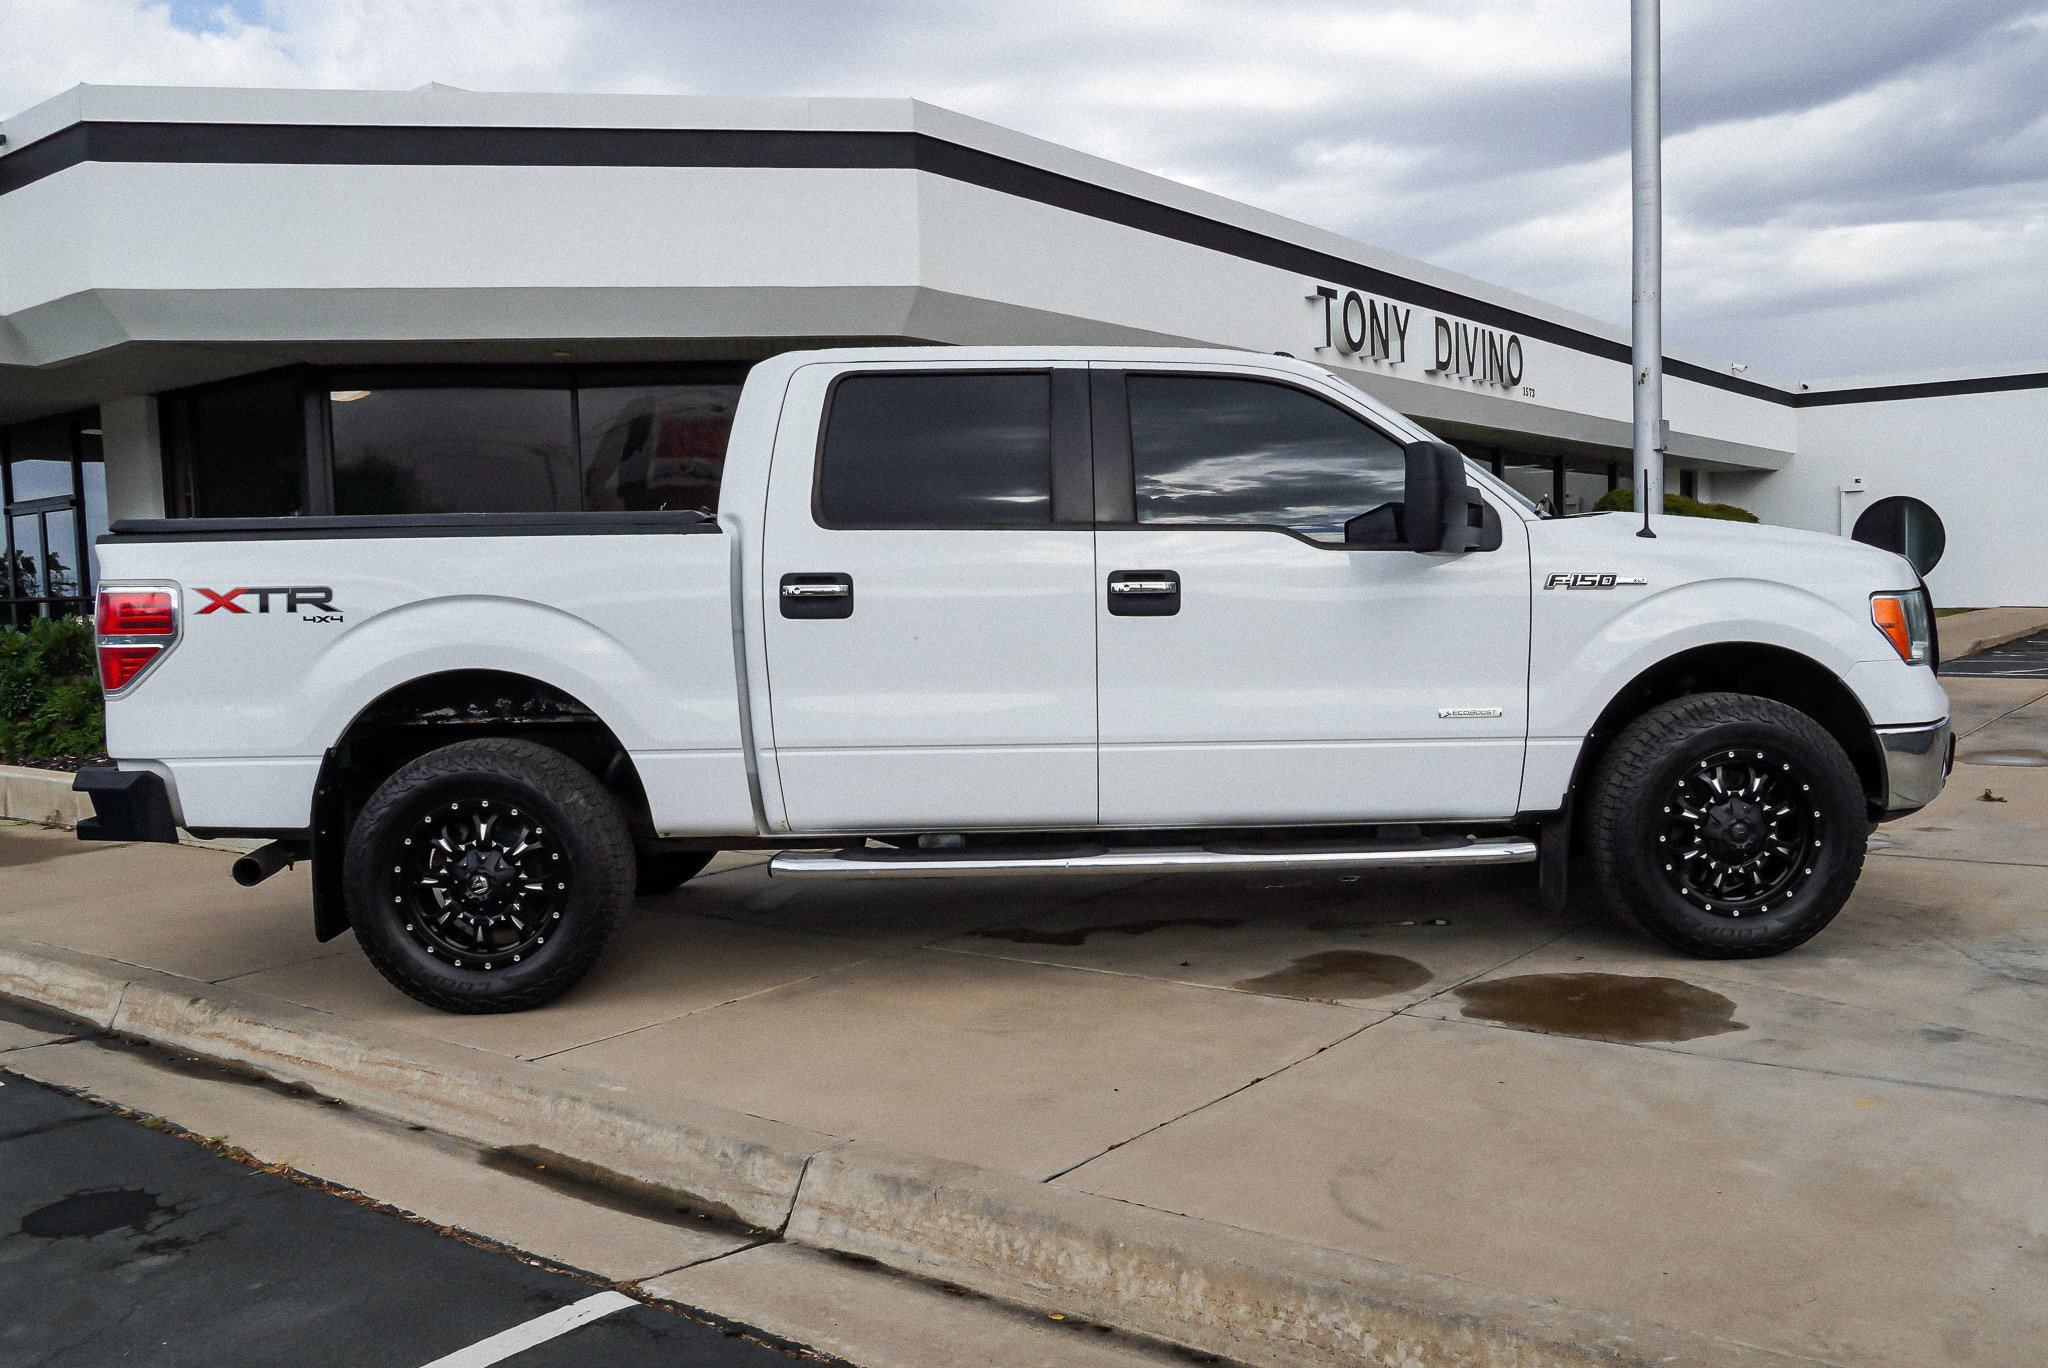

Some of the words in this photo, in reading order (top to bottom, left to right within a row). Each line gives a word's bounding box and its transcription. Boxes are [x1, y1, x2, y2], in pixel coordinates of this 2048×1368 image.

[1316, 285, 1411, 363] TONY
[1434, 316, 1523, 386] DIVINO
[1522, 386, 1536, 398] 1573
[1543, 573, 1619, 590] F-150
[191, 586, 344, 615] XTR
